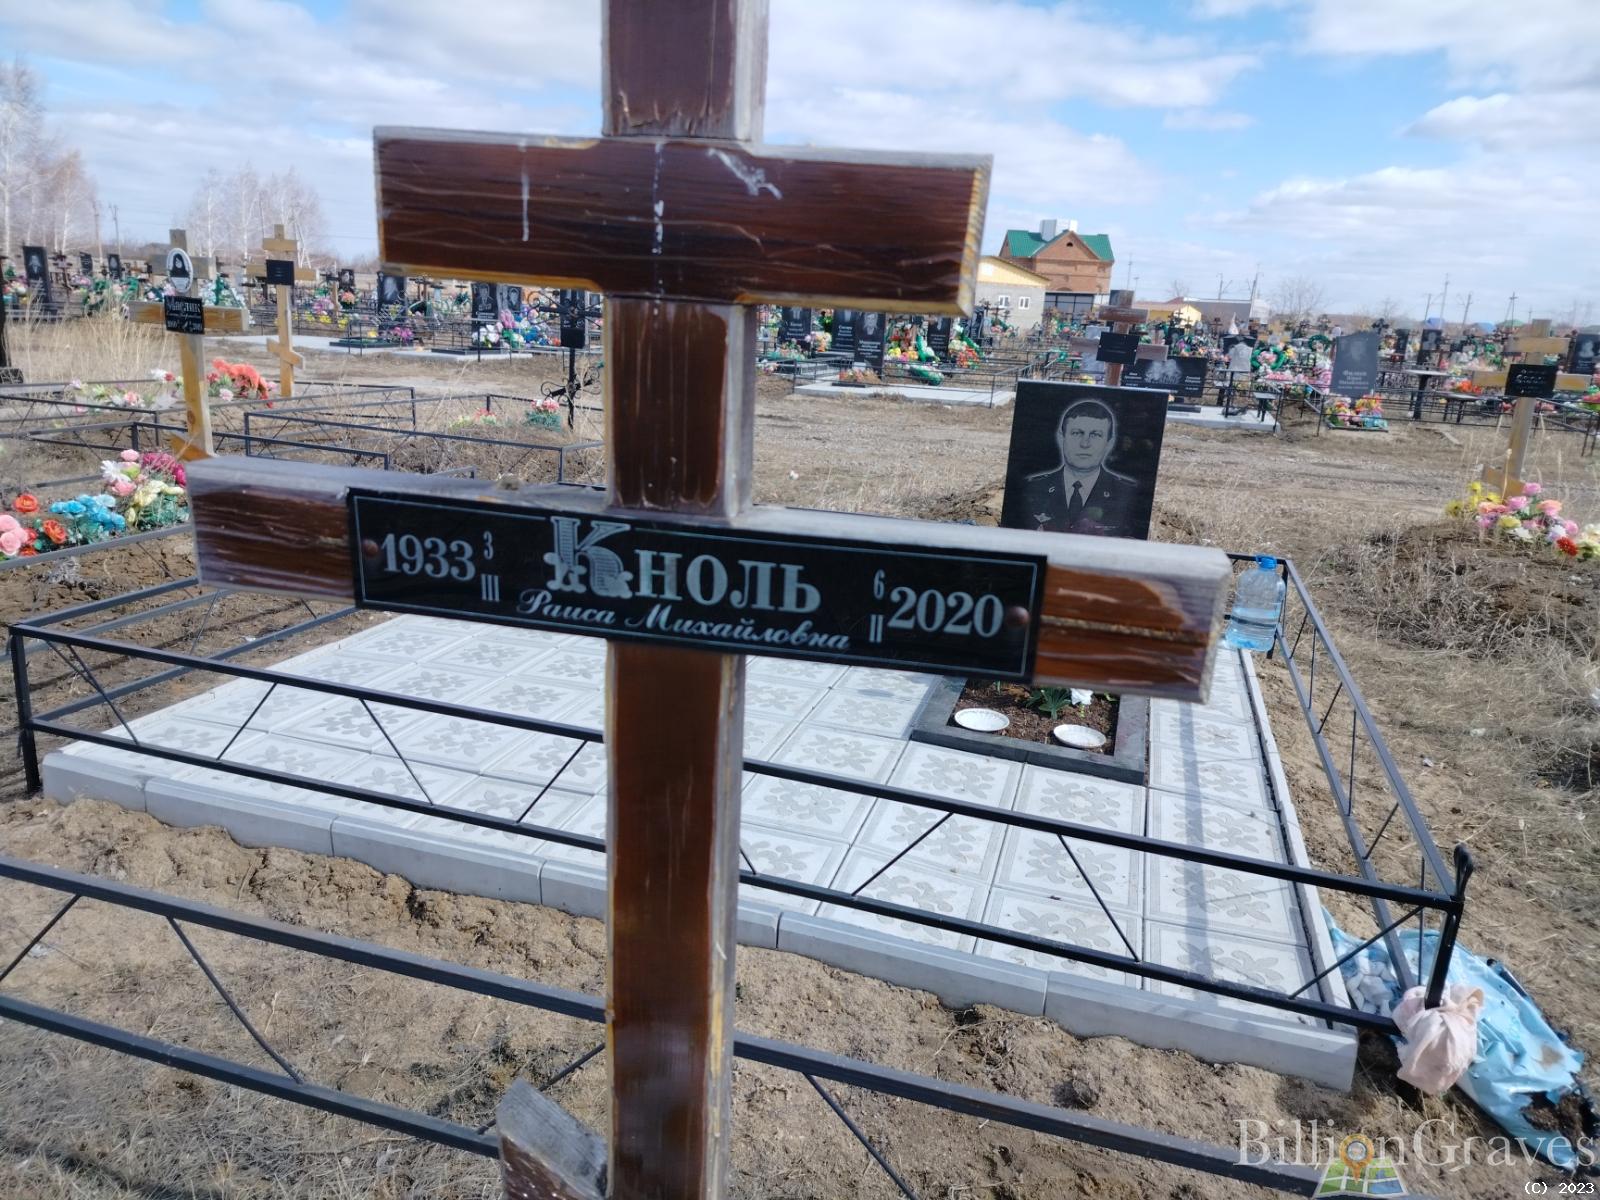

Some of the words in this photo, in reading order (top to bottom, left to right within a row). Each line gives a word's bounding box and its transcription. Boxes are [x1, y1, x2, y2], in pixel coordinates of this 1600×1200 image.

[381, 532, 476, 582] 1933
[483, 531, 494, 560] 3
[873, 569, 885, 599] 6
[516, 588, 616, 625] Раиса
[624, 603, 850, 650] Михайловна
[887, 586, 1004, 638] 2020
